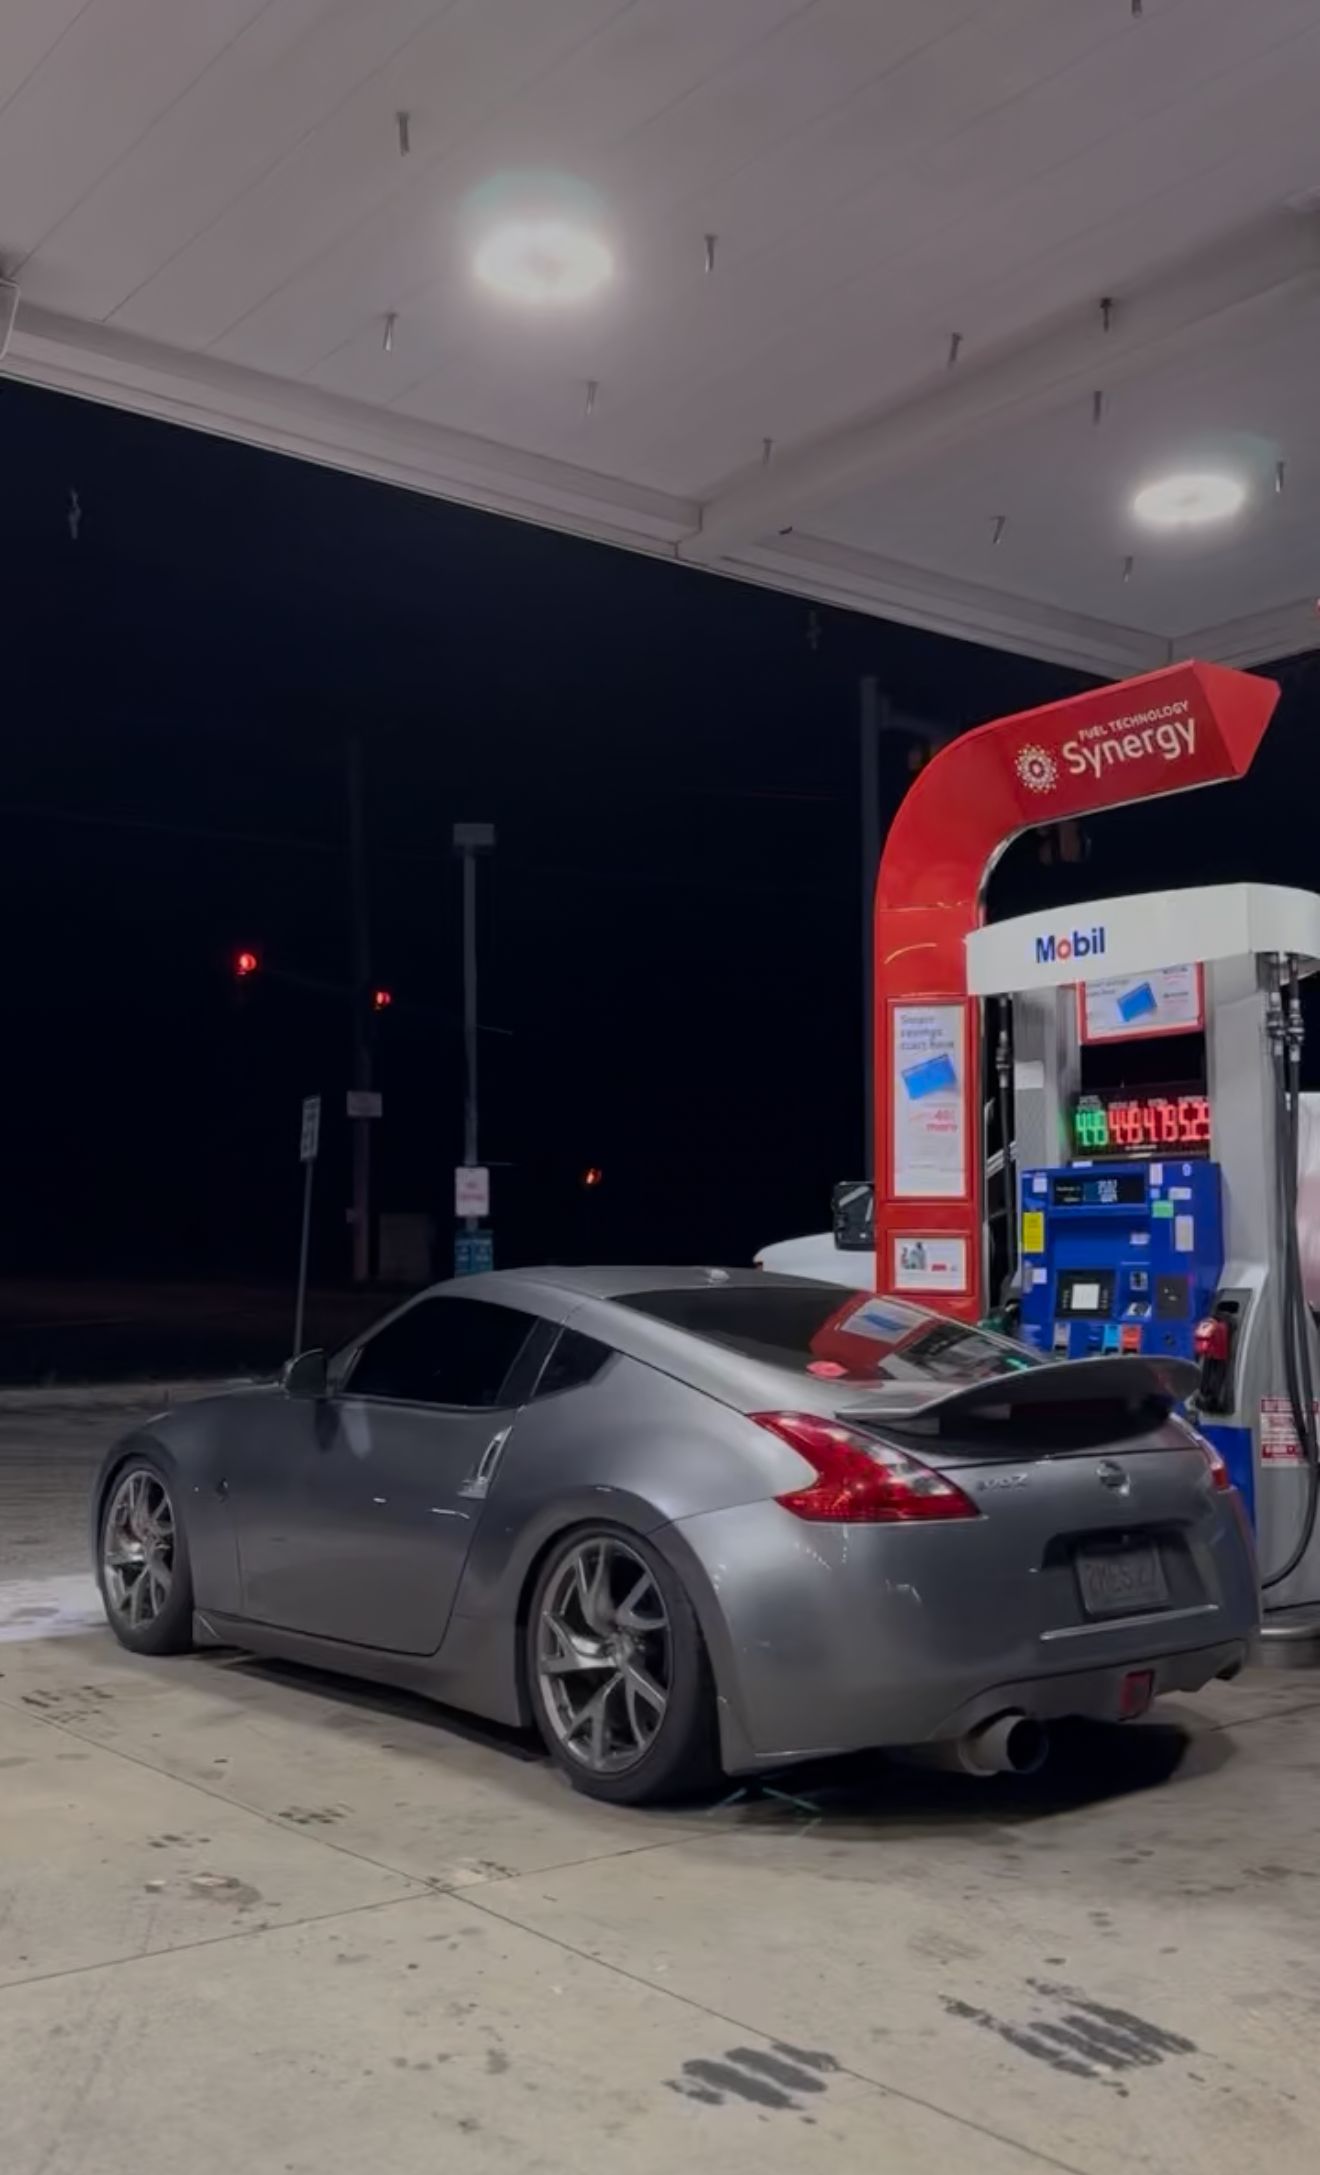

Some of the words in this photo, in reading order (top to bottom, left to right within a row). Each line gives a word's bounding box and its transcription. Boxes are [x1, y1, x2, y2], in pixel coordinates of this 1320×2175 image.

[1078, 725, 1108, 742] FUEL
[1107, 700, 1189, 732] TECHNOLOGY
[1061, 717, 1195, 778] Synergy
[1035, 926, 1105, 964] Mobil
